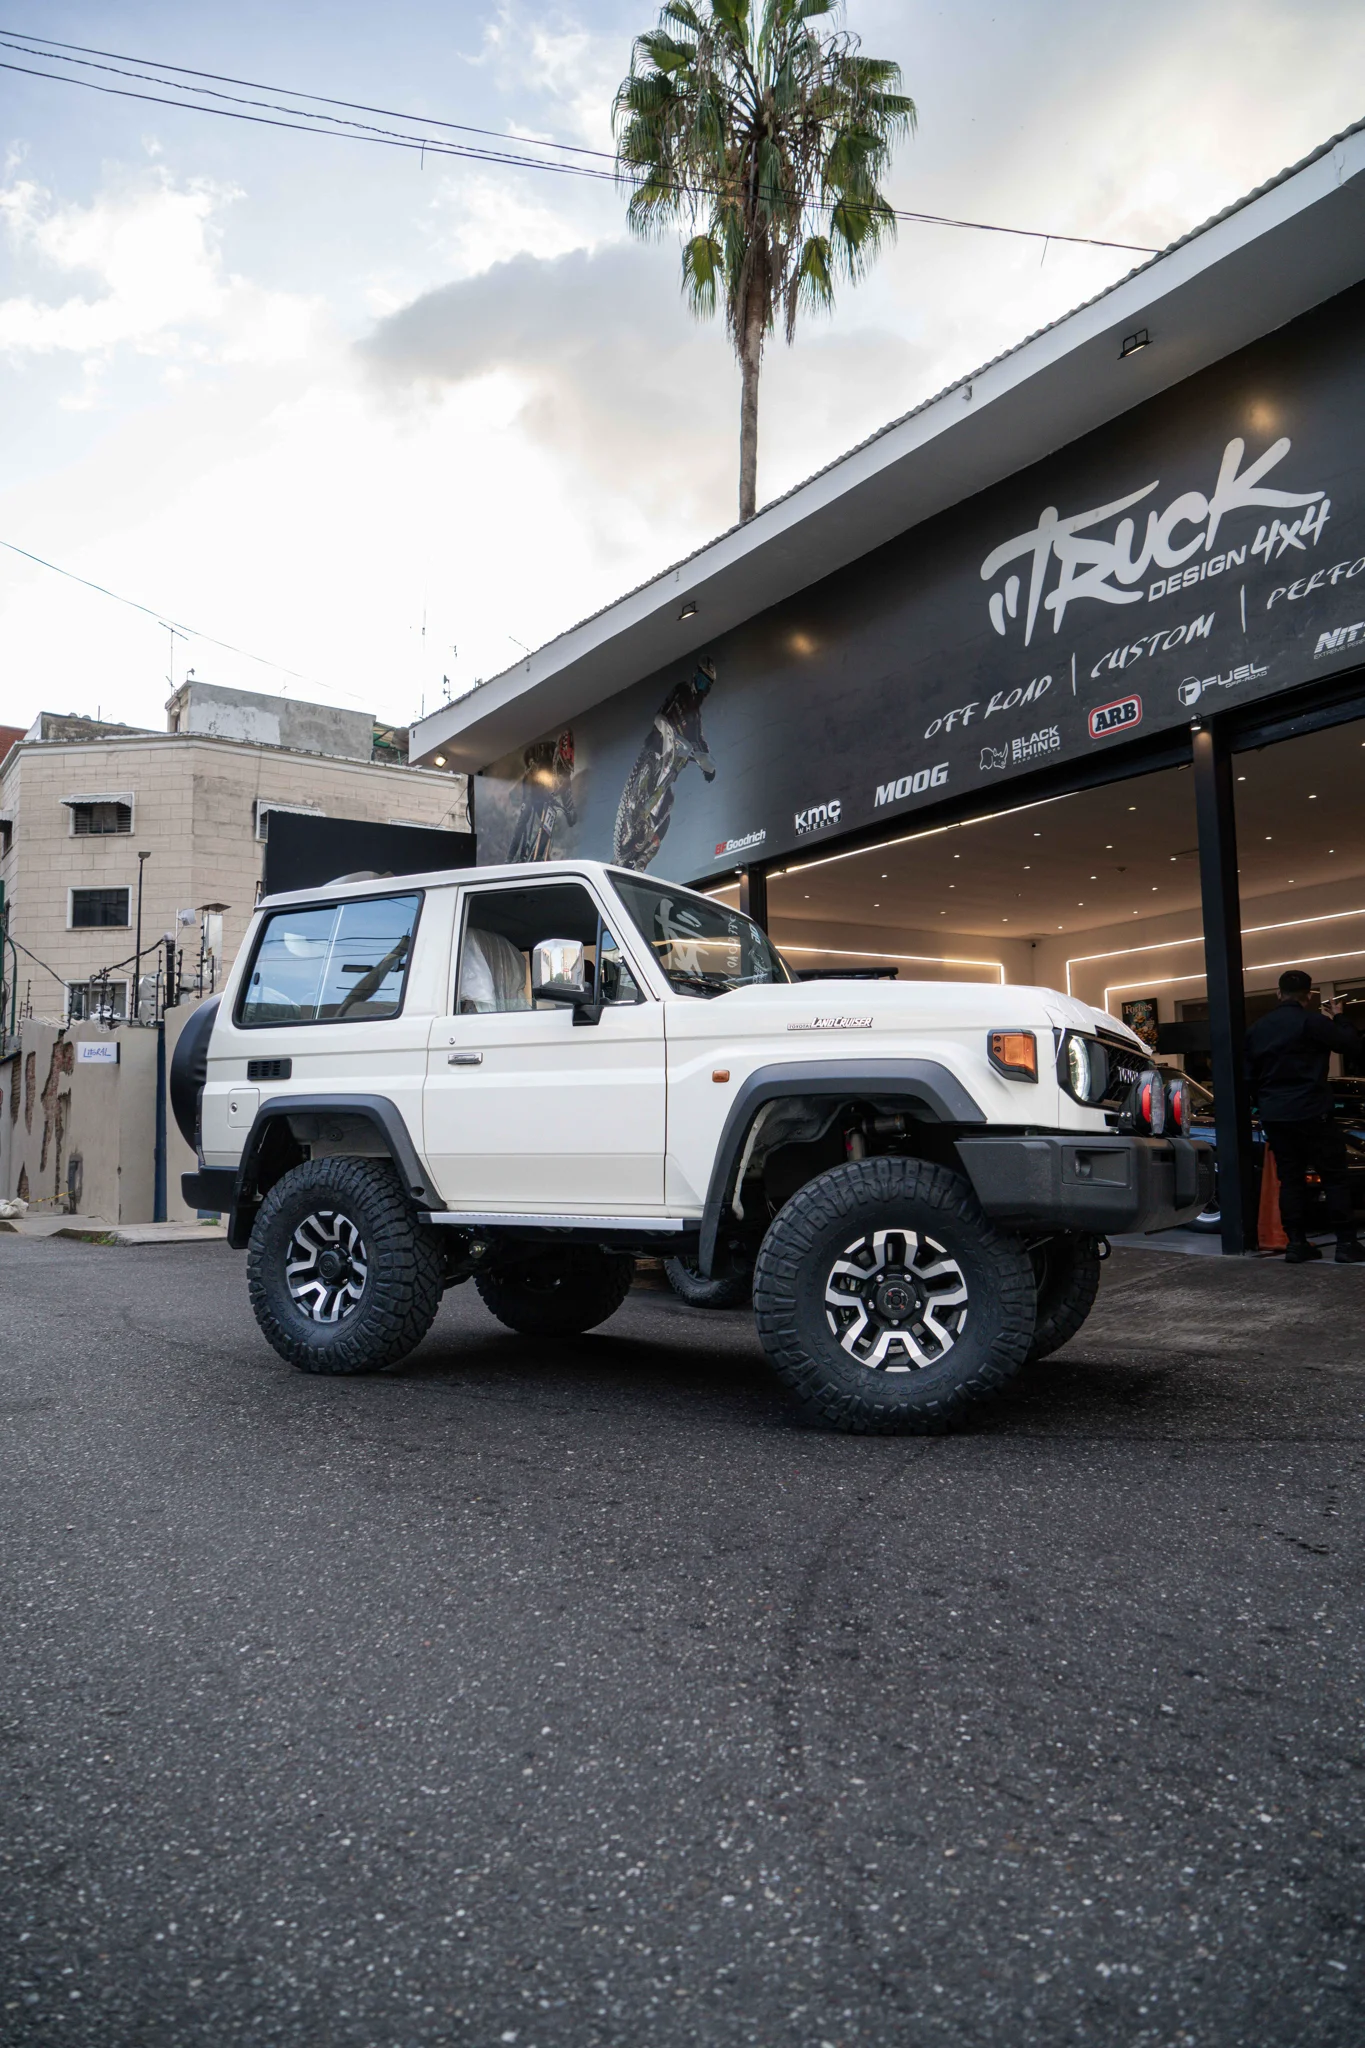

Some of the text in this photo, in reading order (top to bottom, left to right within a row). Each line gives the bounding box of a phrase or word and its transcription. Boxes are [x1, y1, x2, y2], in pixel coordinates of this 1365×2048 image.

[980, 437, 1326, 646] TRUCK
[1148, 545, 1247, 602] DESIGN
[1314, 621, 1365, 654] NIT
[924, 702, 980, 739] OFF
[984, 675, 1053, 719] ROAD
[1091, 612, 1215, 678] CUSTOM
[1202, 663, 1267, 692] FUEL
[1095, 702, 1137, 732] ARB
[1012, 725, 1058, 750] BLACK
[1012, 736, 1060, 761] RHINO
[874, 762, 949, 808] MOOG
[797, 815, 839, 835] WHEELS
[714, 828, 766, 855] BFGoodrich
[1125, 1003, 1153, 1014] Forbes
